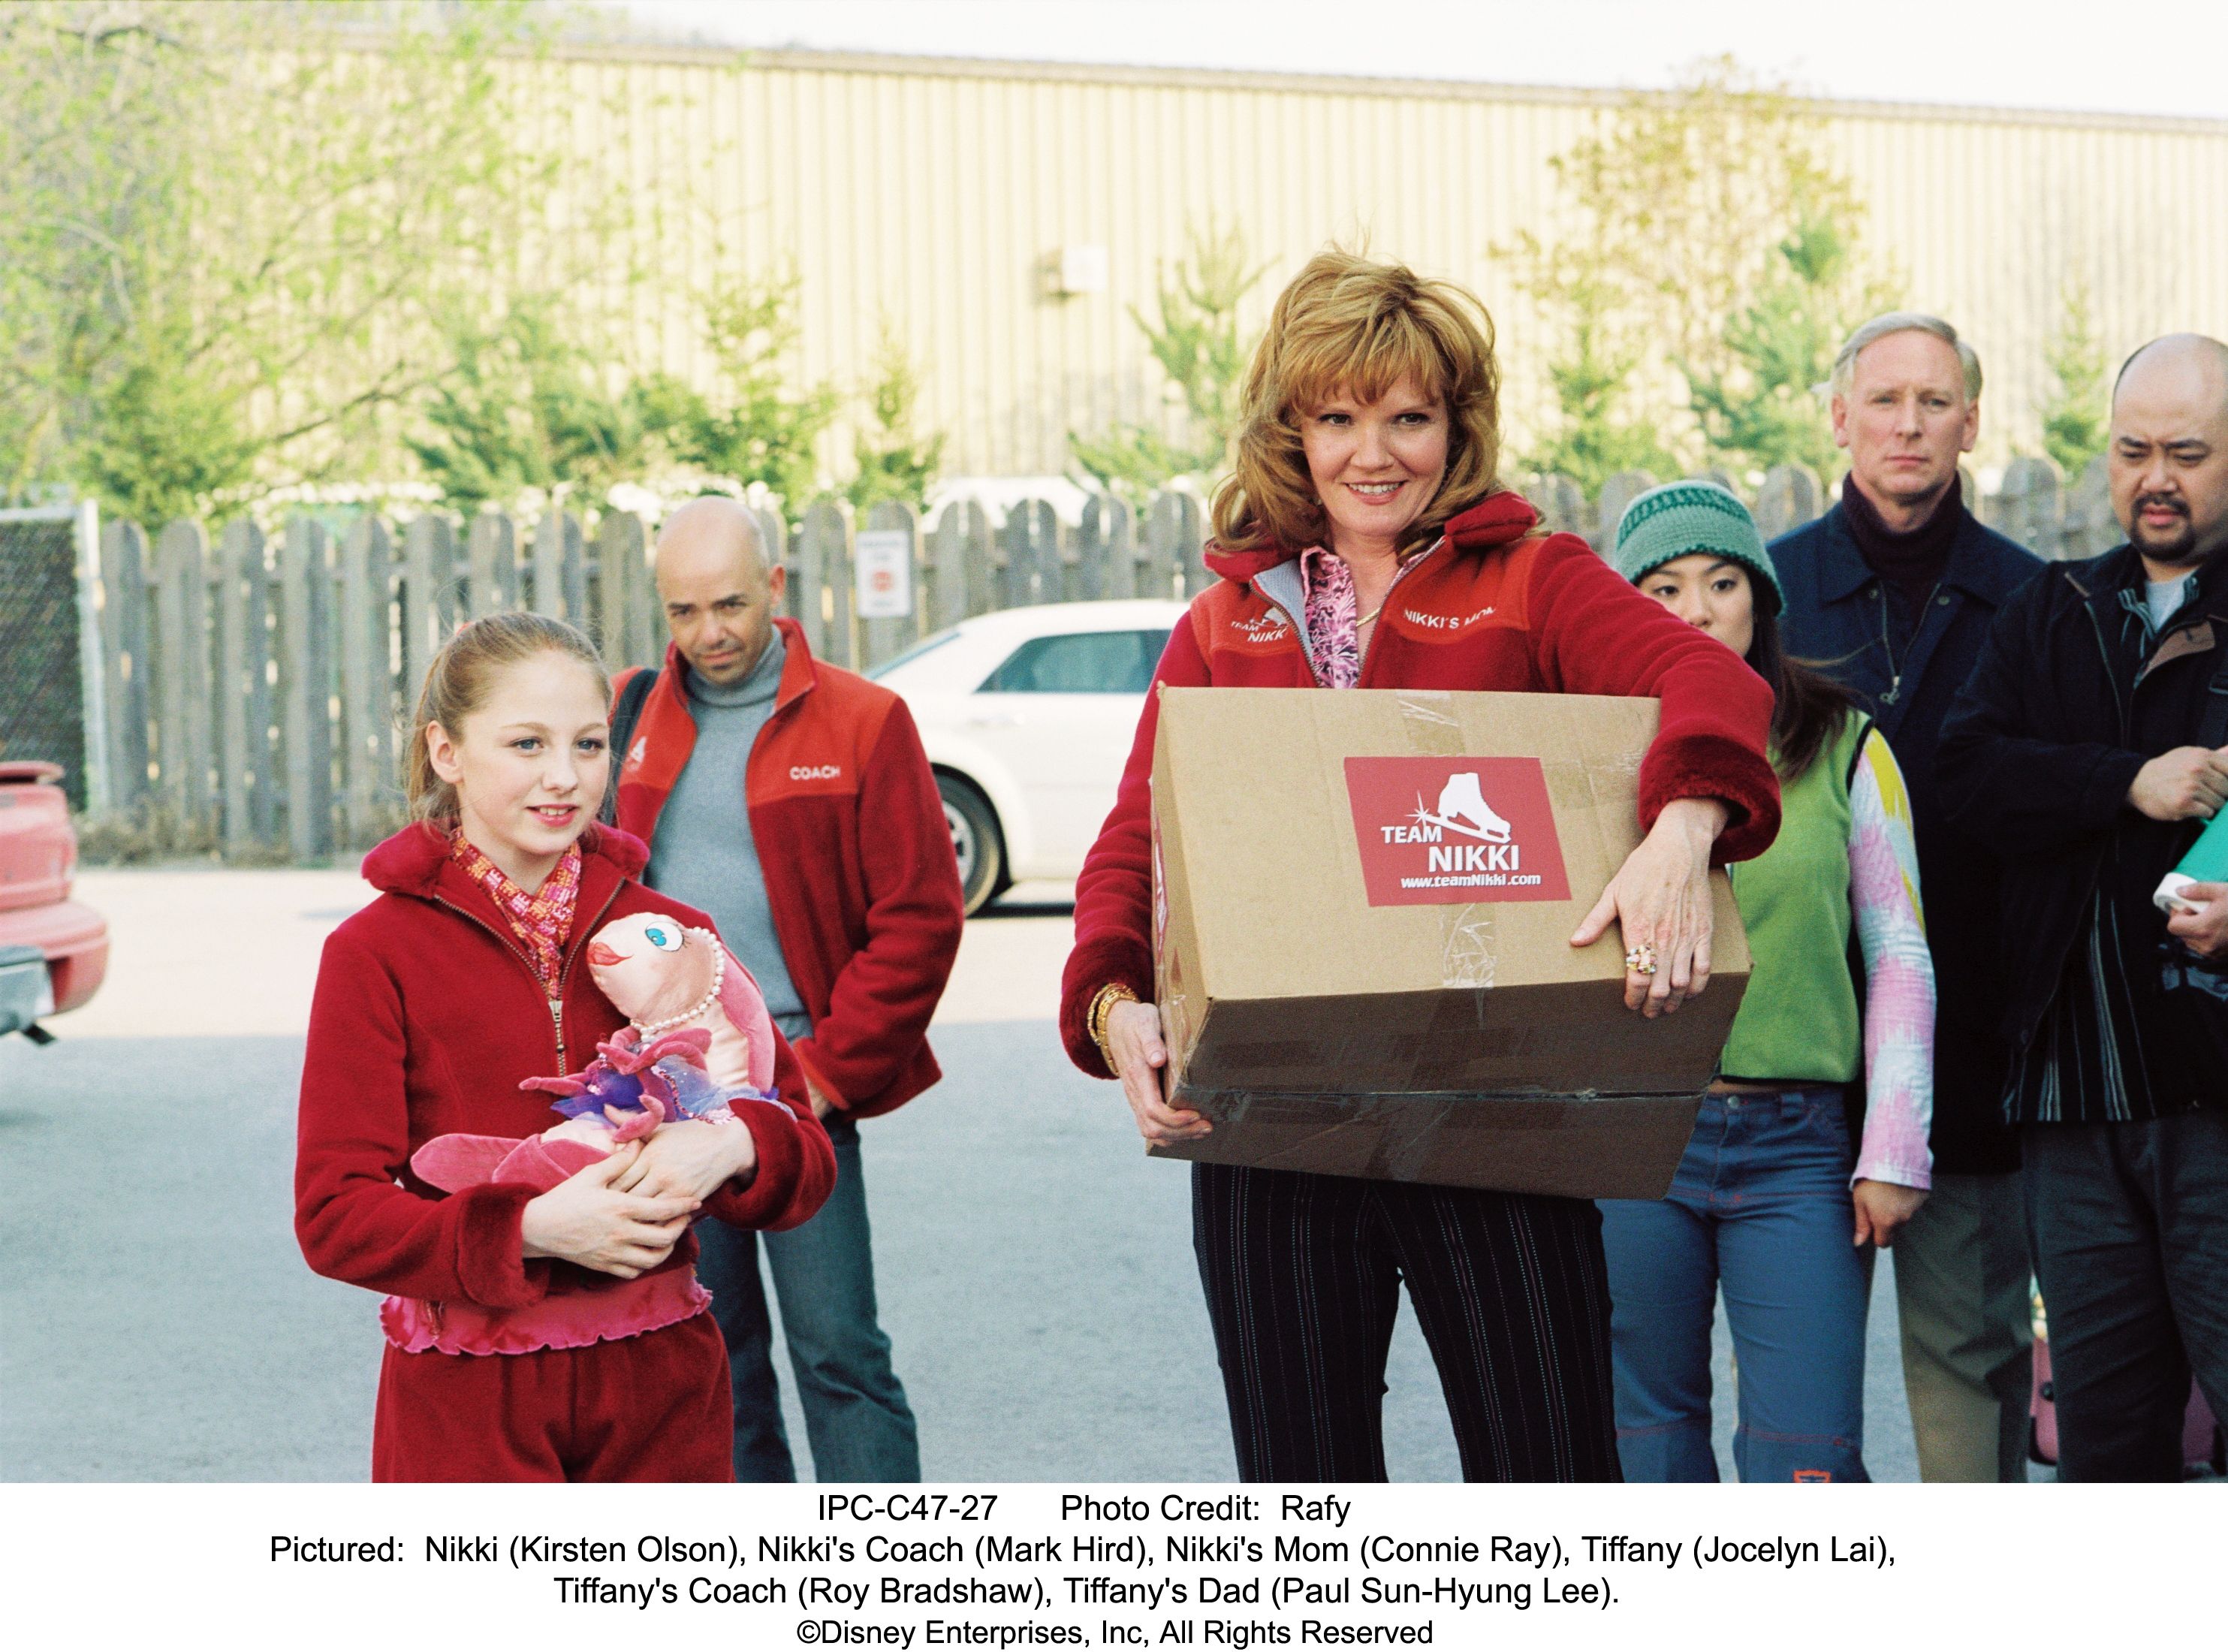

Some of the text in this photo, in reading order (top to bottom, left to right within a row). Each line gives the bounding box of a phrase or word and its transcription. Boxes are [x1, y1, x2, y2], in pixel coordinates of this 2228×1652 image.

[1404, 608, 1460, 629] NIKKI'S
[789, 765, 841, 781] COACH
[1380, 825, 1443, 844] TEAM
[1428, 845, 1520, 873] NIKKI
[1401, 874, 1541, 888] www.teamNikki.com
